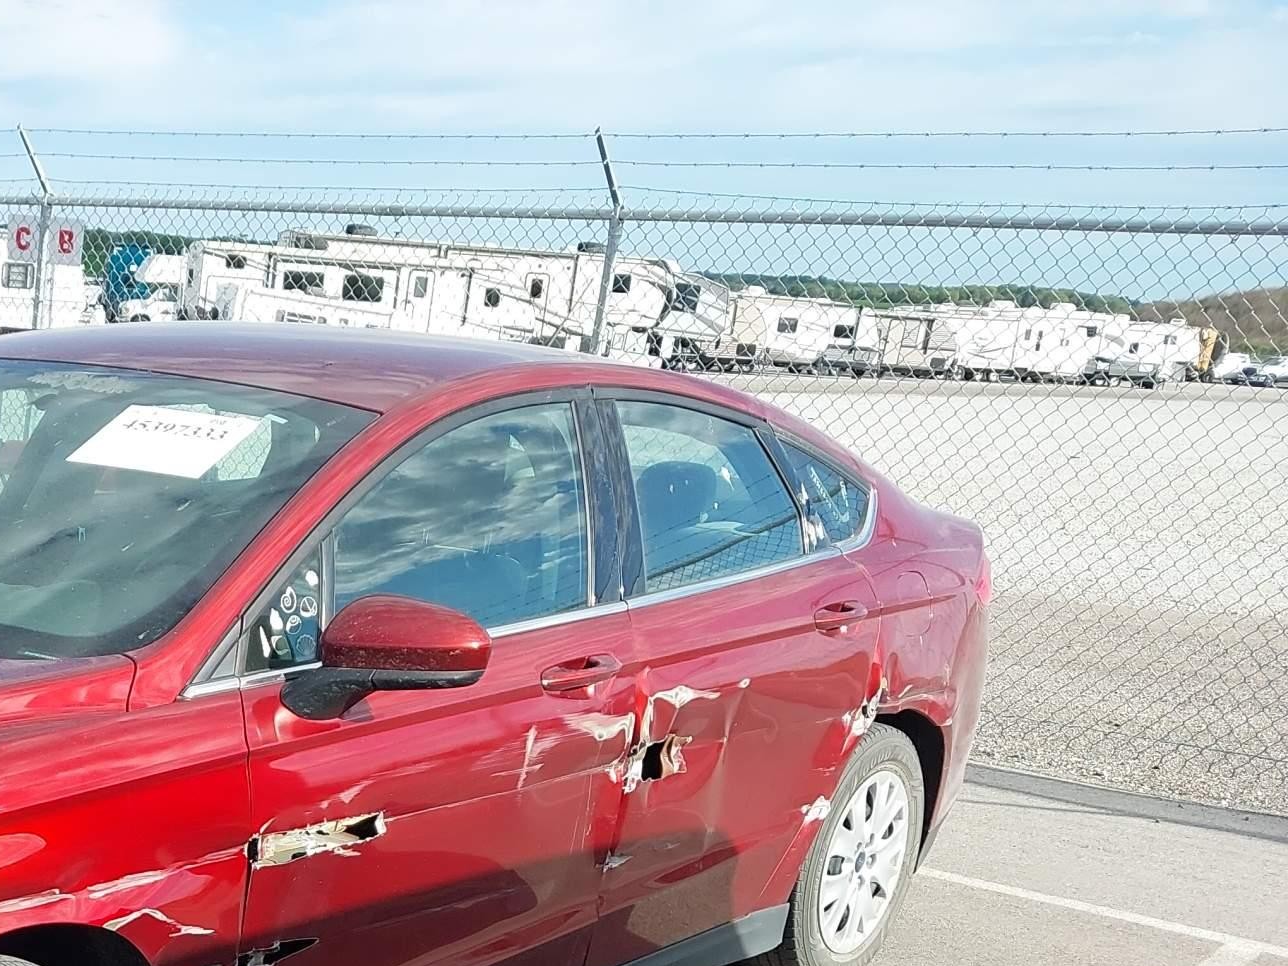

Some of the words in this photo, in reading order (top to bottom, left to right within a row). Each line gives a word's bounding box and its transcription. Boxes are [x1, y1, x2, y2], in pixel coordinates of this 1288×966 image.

[15, 226, 32, 251] C
[57, 229, 75, 254] B
[122, 419, 229, 441] 45397333
